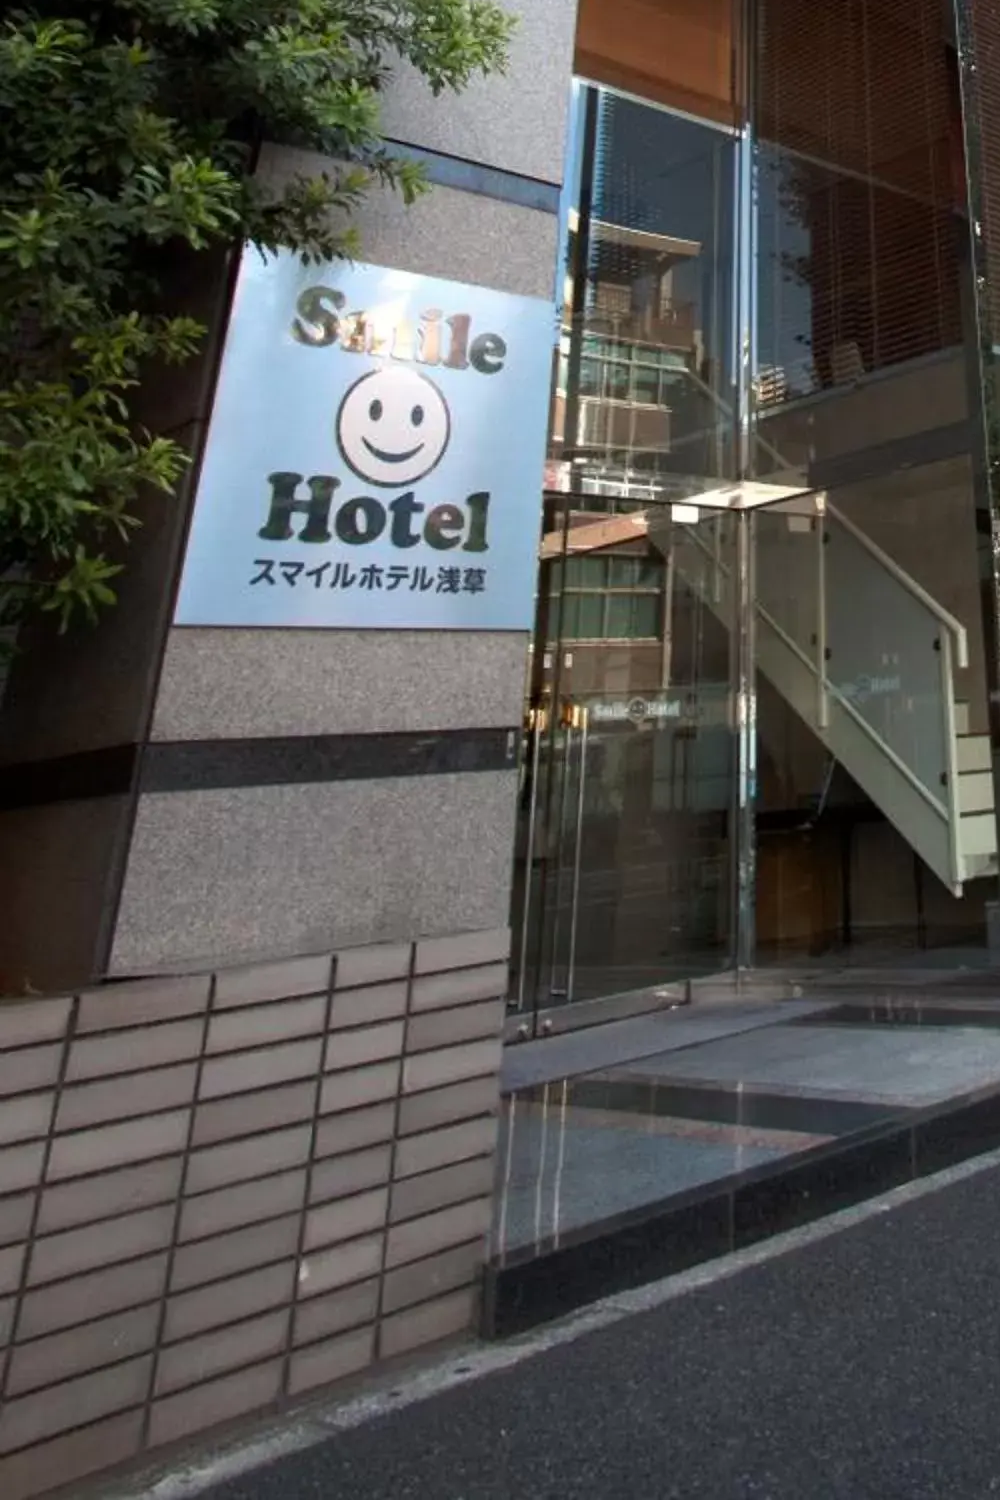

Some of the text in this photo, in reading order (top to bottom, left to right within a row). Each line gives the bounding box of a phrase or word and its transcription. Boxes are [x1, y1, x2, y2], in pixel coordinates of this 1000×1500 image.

[256, 471, 491, 553] Hotel
[249, 559, 487, 594] スマイルホテル浅草
